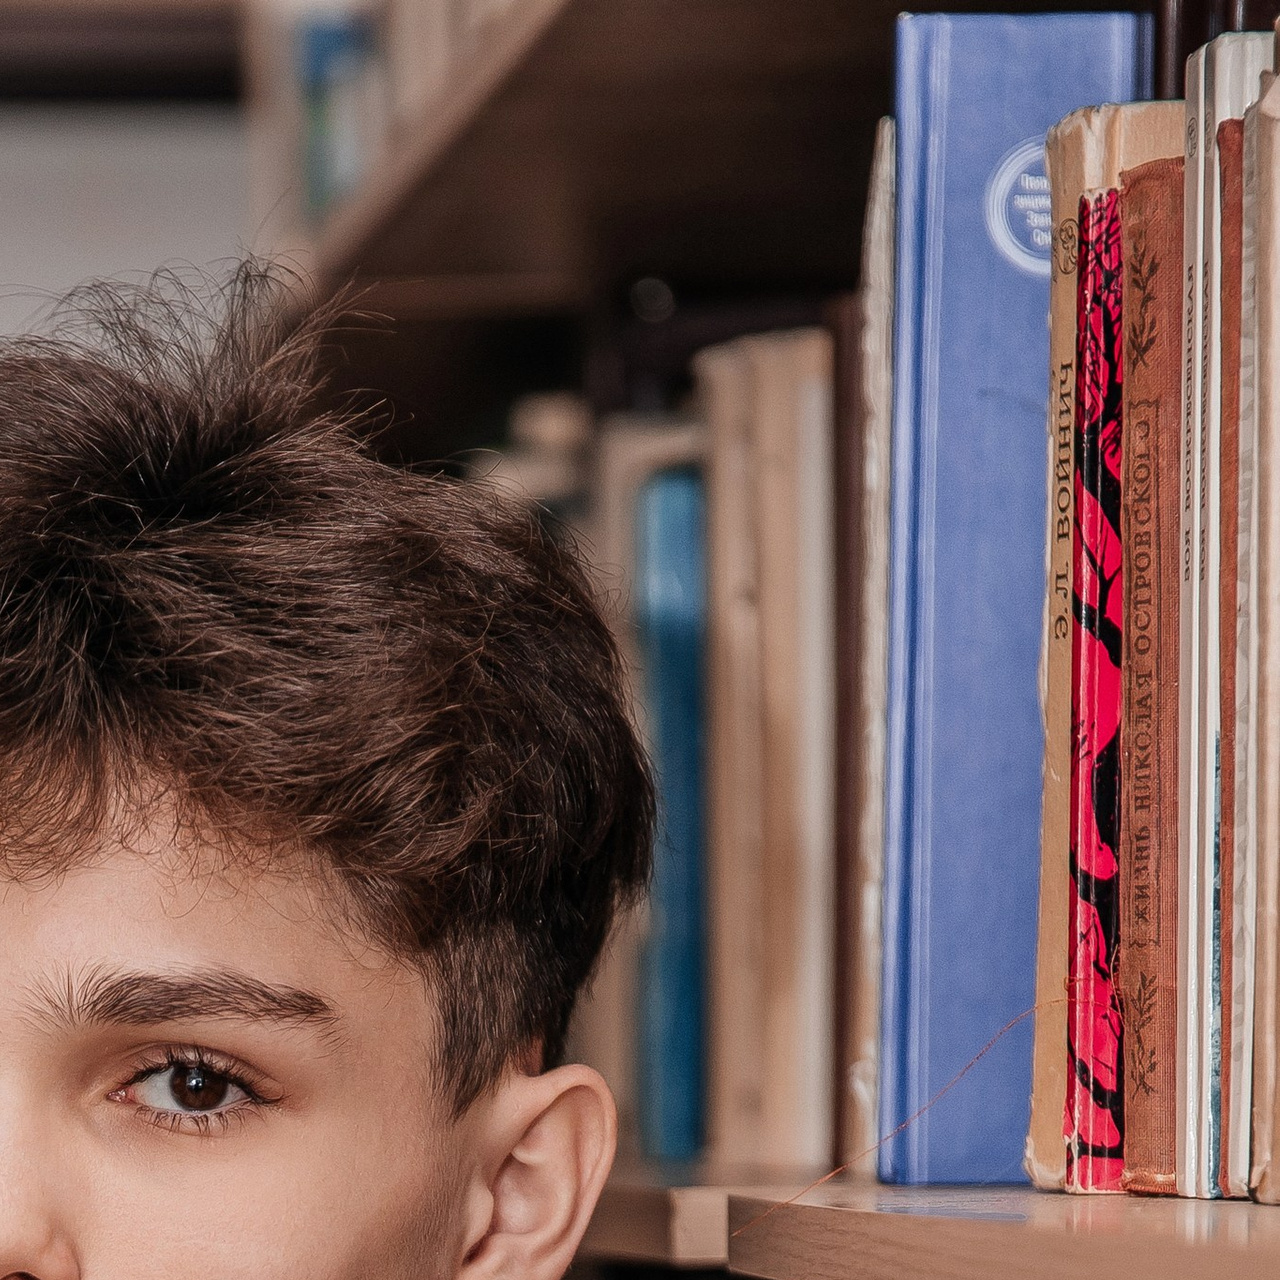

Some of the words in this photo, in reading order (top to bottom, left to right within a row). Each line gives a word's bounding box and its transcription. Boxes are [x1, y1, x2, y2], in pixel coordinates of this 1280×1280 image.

[1056, 360, 1074, 543] ВОЙНИЧ
[1054, 560, 1069, 600] Л.
[1133, 417, 1152, 656] ОСТРОВСКОГО
[1054, 606, 1068, 641] Э.
[1134, 668, 1152, 815] НИКОЛАЯ
[1133, 825, 1150, 926] ЖИЗНЬ
